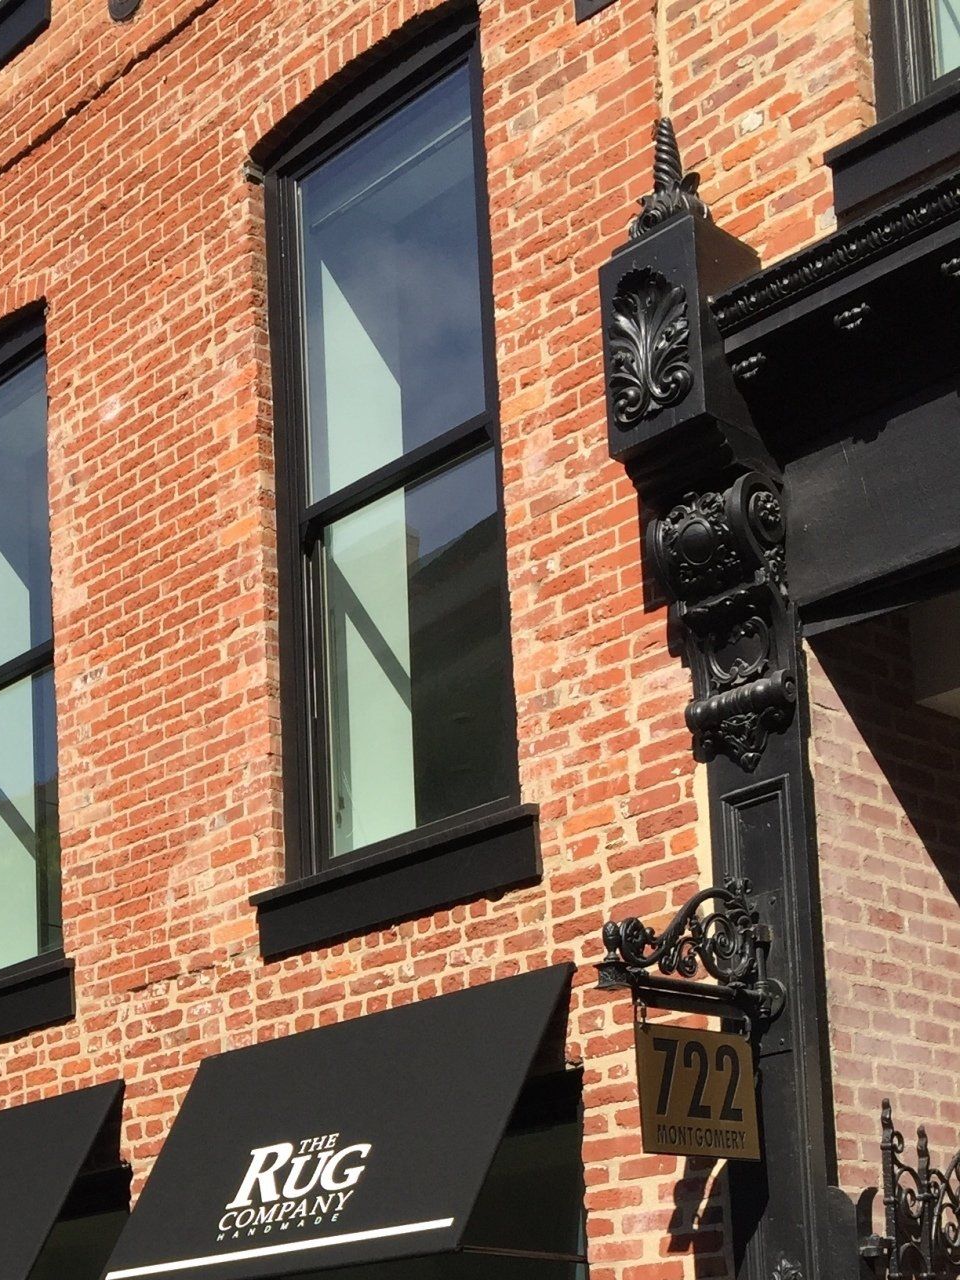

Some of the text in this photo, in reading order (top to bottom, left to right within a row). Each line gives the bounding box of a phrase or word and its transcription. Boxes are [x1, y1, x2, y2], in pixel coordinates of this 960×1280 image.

[652, 1037, 744, 1122] 722
[298, 1132, 340, 1154] THE
[657, 1123, 746, 1150] MONTGOMERY
[225, 1142, 372, 1210] RUG
[216, 1213, 340, 1241] HANDMADE
[218, 1189, 354, 1231] COMPANY
